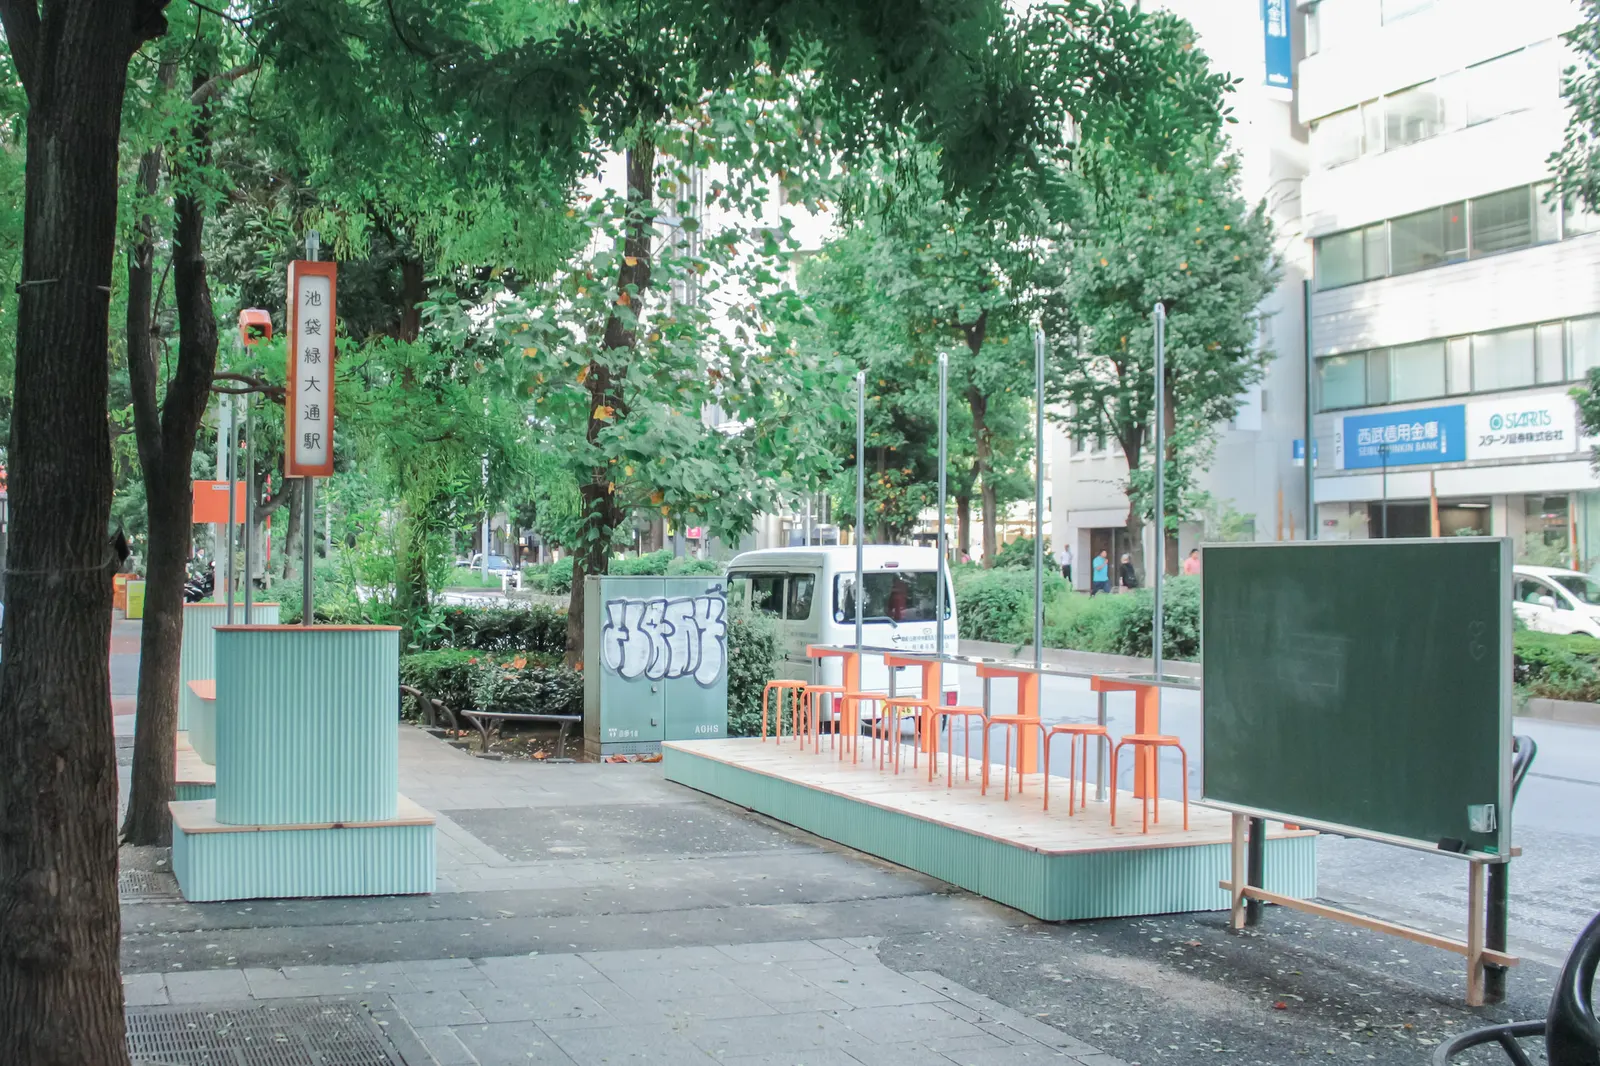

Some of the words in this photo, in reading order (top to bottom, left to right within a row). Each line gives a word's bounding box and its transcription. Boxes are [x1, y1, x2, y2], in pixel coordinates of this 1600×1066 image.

[303, 289, 322, 450] 池袋緑大通駅
